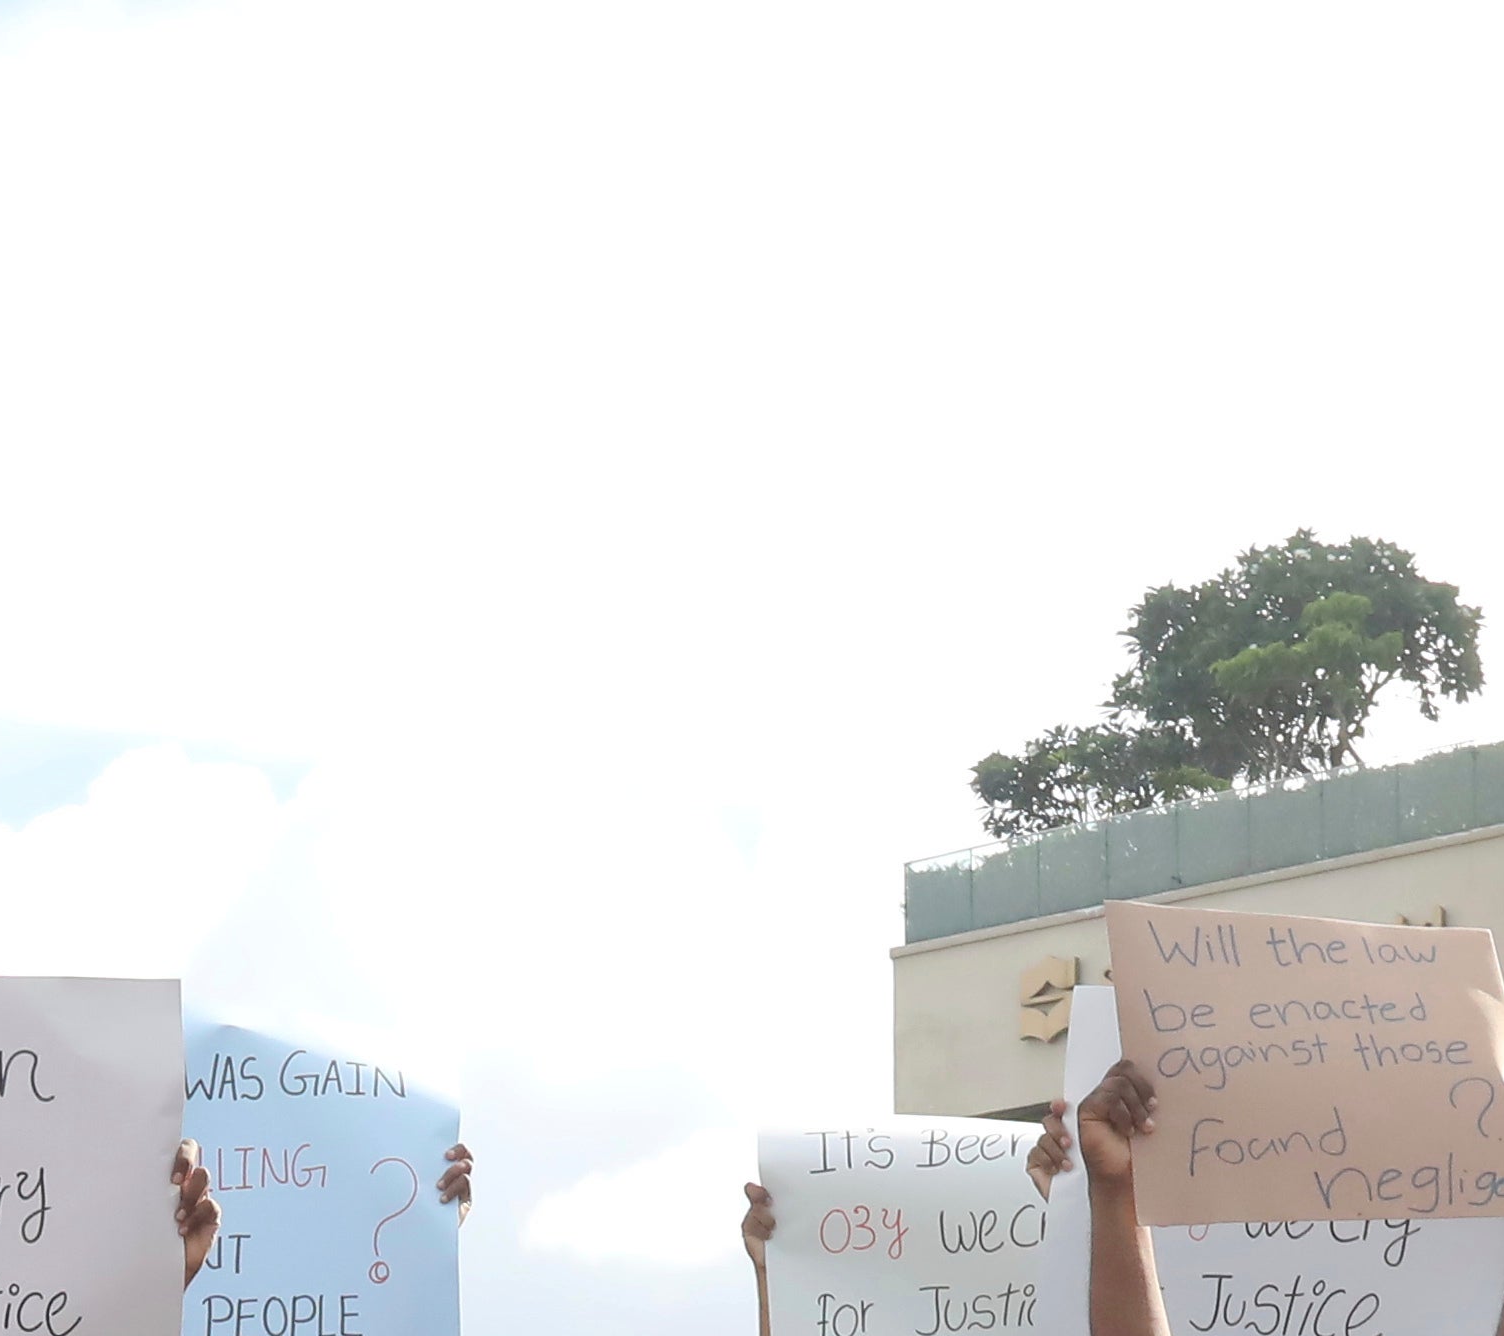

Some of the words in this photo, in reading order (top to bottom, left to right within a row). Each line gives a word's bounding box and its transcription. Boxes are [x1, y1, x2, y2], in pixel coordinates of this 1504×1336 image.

[1148, 920, 1241, 967] Will
[1266, 926, 1348, 968] the
[1363, 937, 1437, 965] law
[1144, 989, 1216, 1034] be
[1249, 992, 1427, 1029] enacted
[1158, 1033, 1330, 1091] against
[1354, 1033, 1472, 1072] those
[803, 1128, 894, 1175] It's
